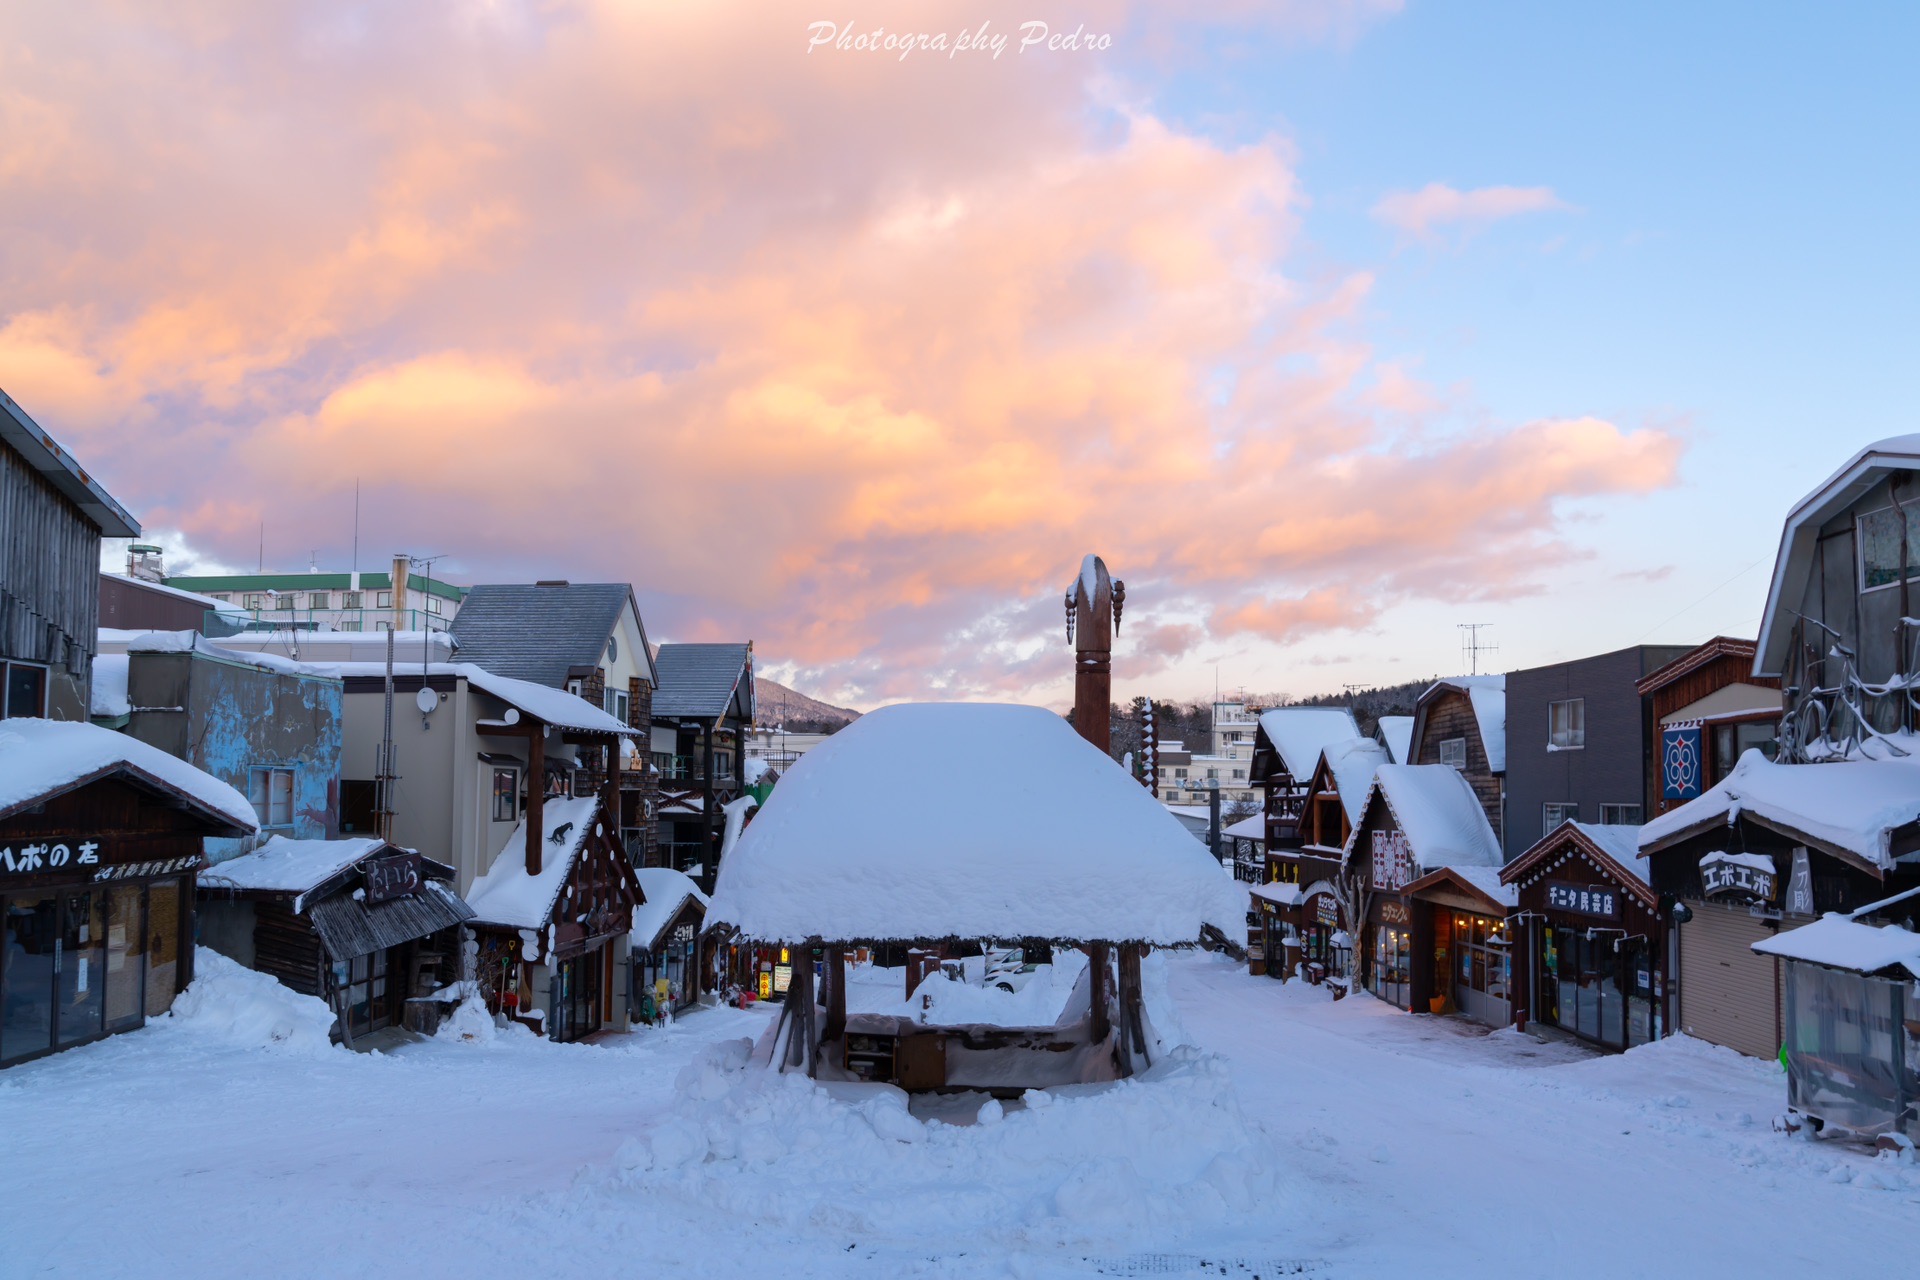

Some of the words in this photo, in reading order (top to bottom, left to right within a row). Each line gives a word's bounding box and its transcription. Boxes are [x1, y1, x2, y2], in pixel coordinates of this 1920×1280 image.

[1703, 864, 1771, 897] エポエポ
[1794, 858, 1810, 911] 一刀彫
